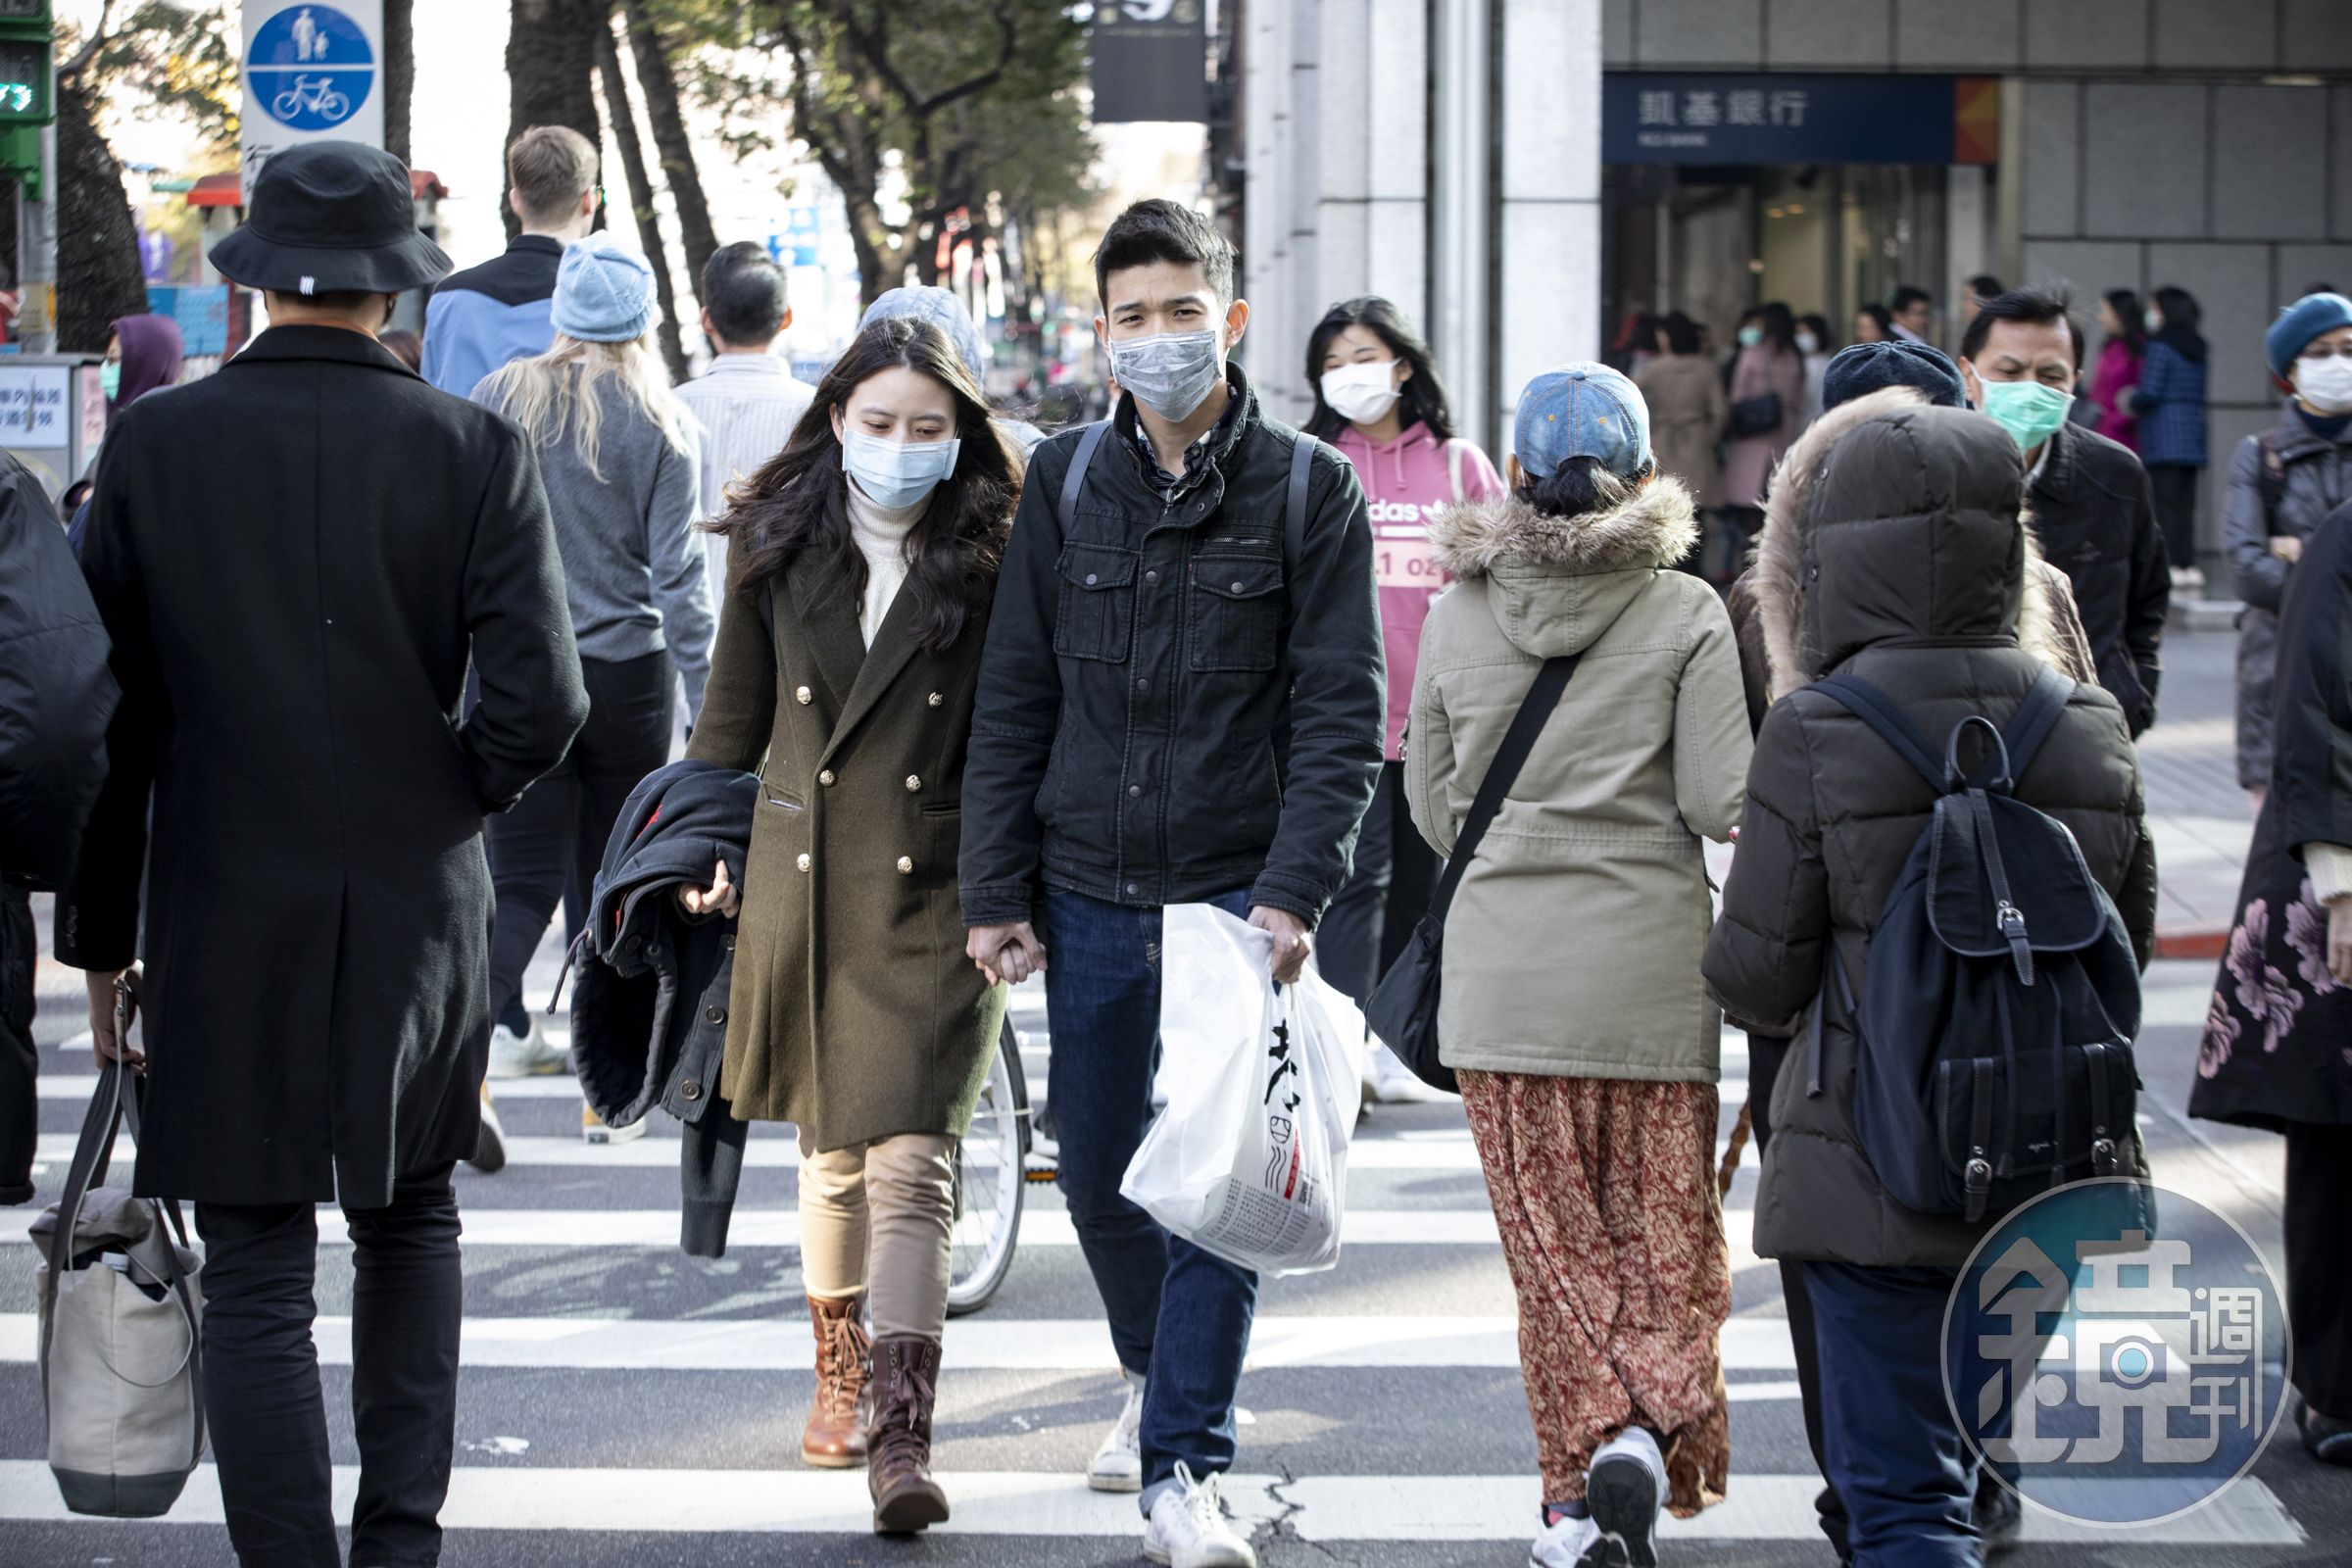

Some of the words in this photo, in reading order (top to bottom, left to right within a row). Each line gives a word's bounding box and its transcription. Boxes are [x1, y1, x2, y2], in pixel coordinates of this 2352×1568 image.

[1639, 90, 1808, 126] 凱基銀行
[1368, 498, 1419, 522] das
